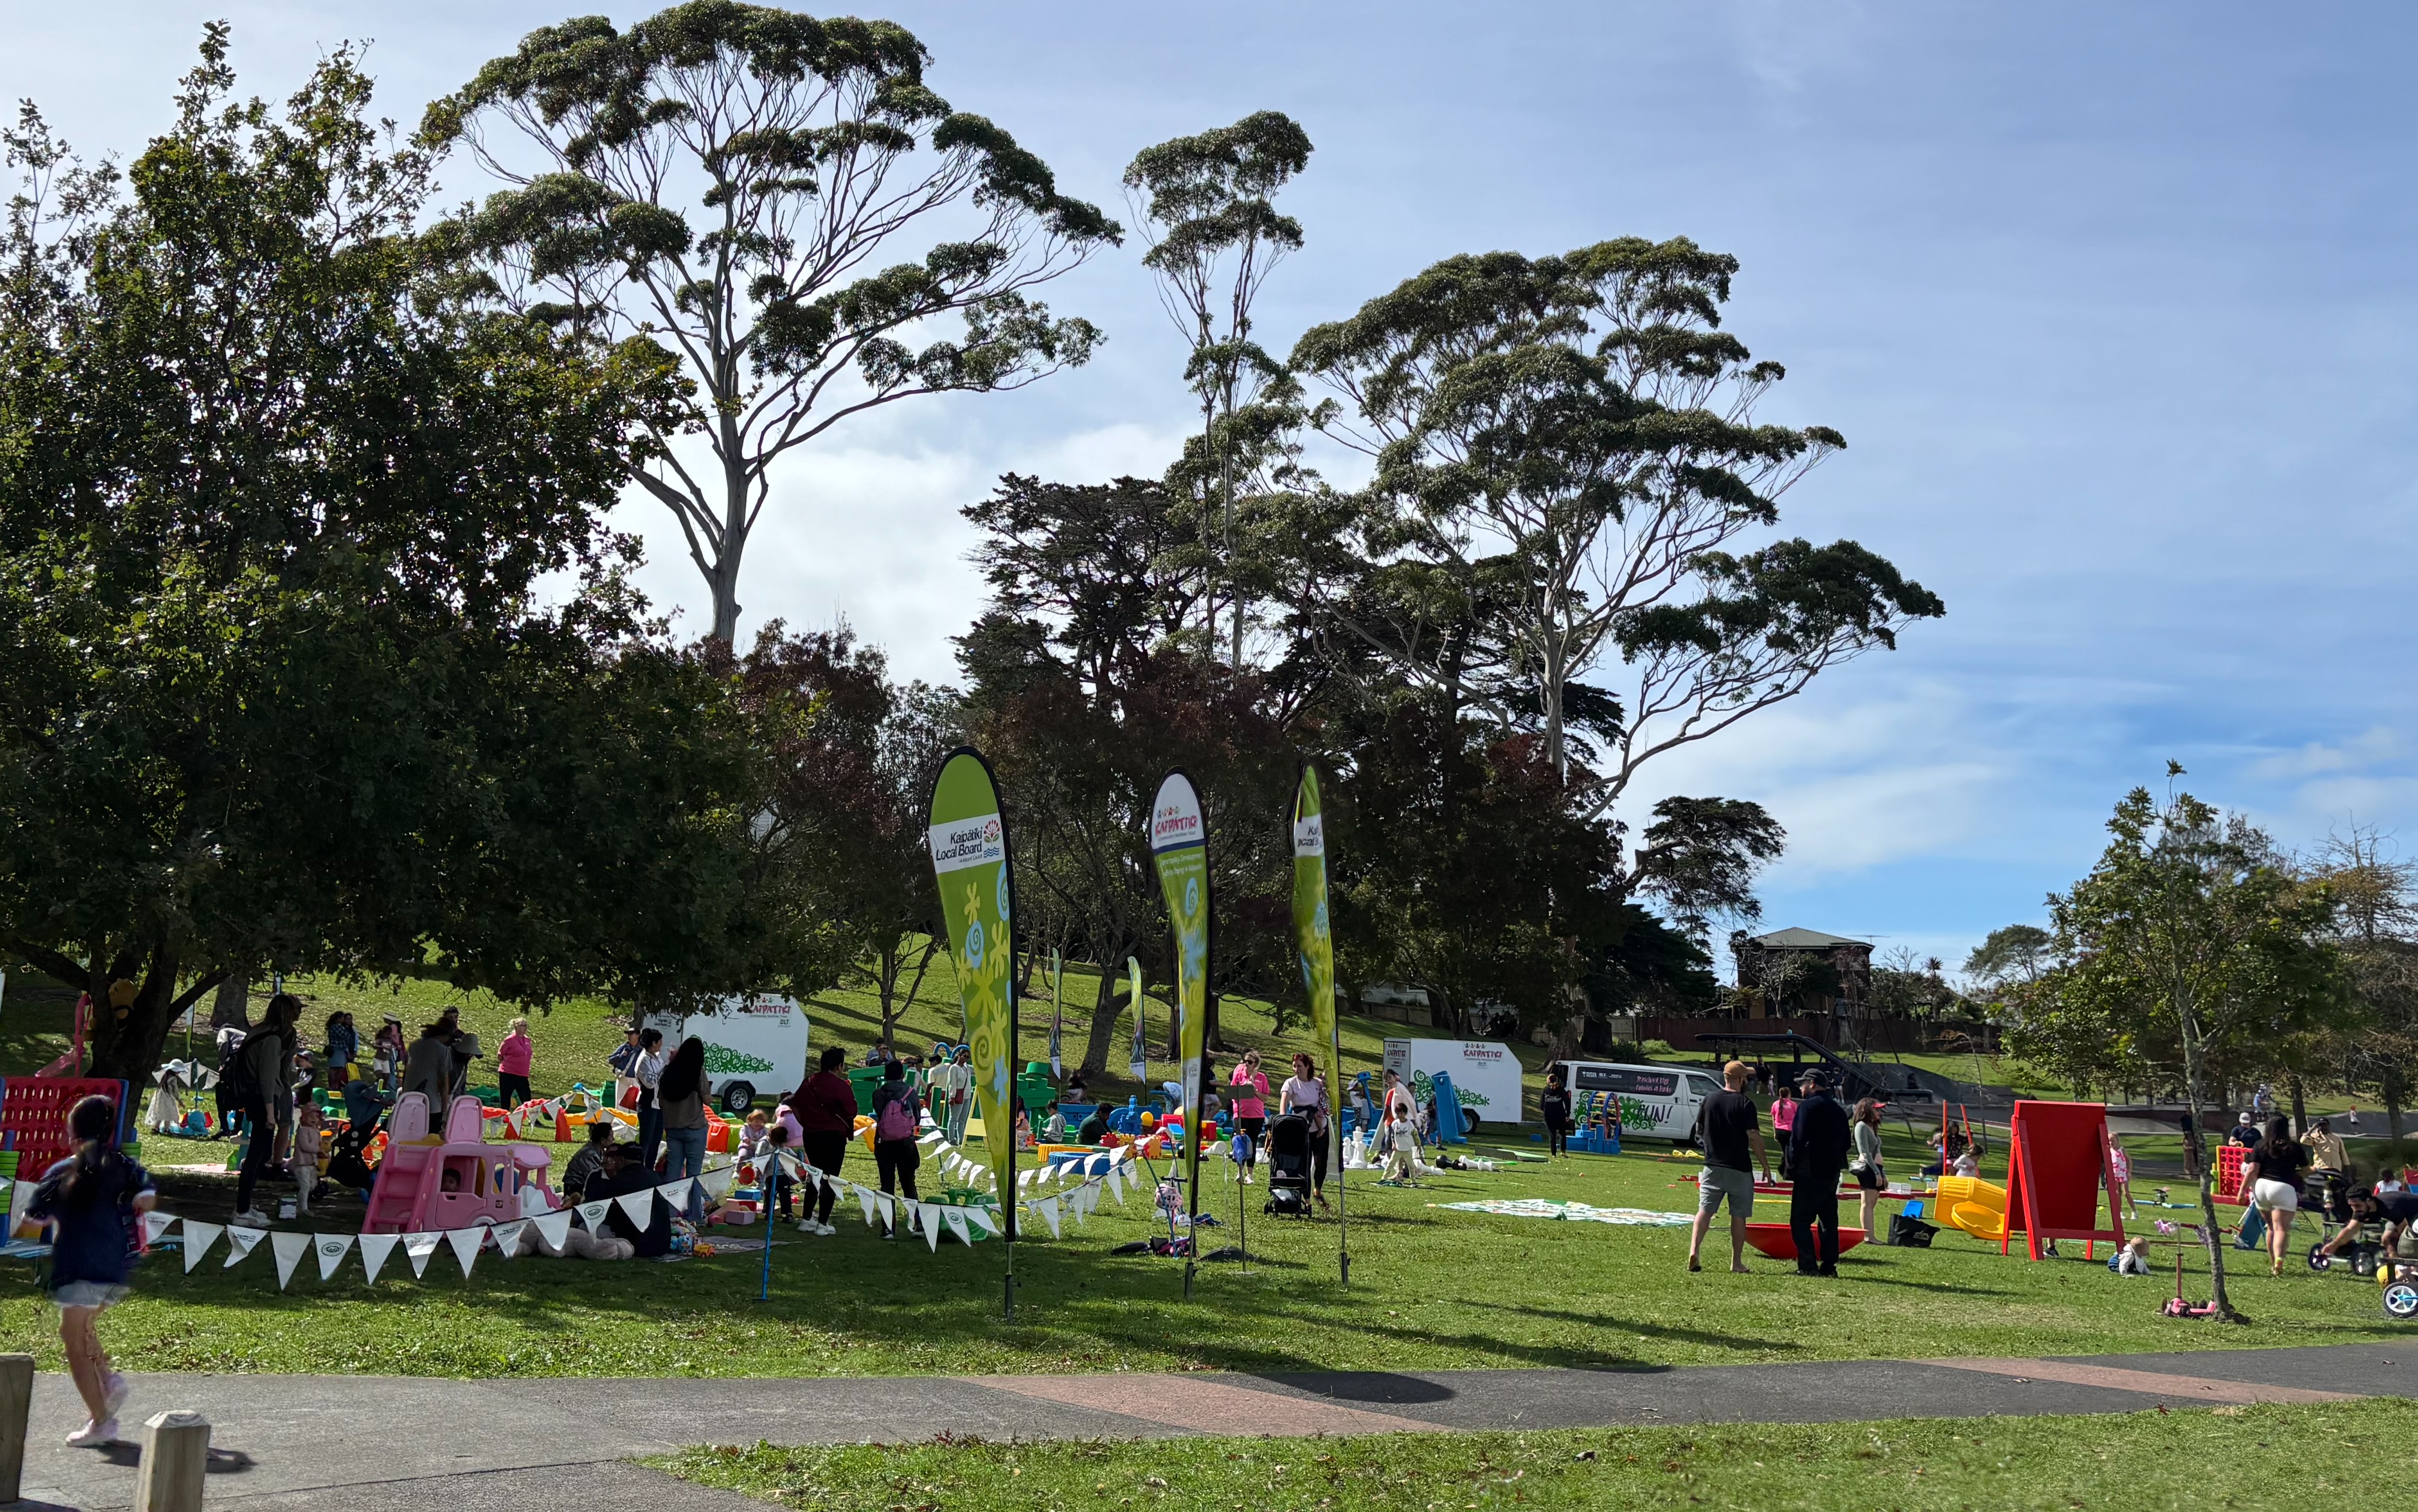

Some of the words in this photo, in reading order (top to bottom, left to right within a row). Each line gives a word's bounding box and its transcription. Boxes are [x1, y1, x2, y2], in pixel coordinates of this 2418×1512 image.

[936, 845, 957, 861] Local
[958, 840, 982, 856] Board
[751, 1005, 791, 1015] AIPATIKI
[1637, 1104, 1673, 1124] FUN!
